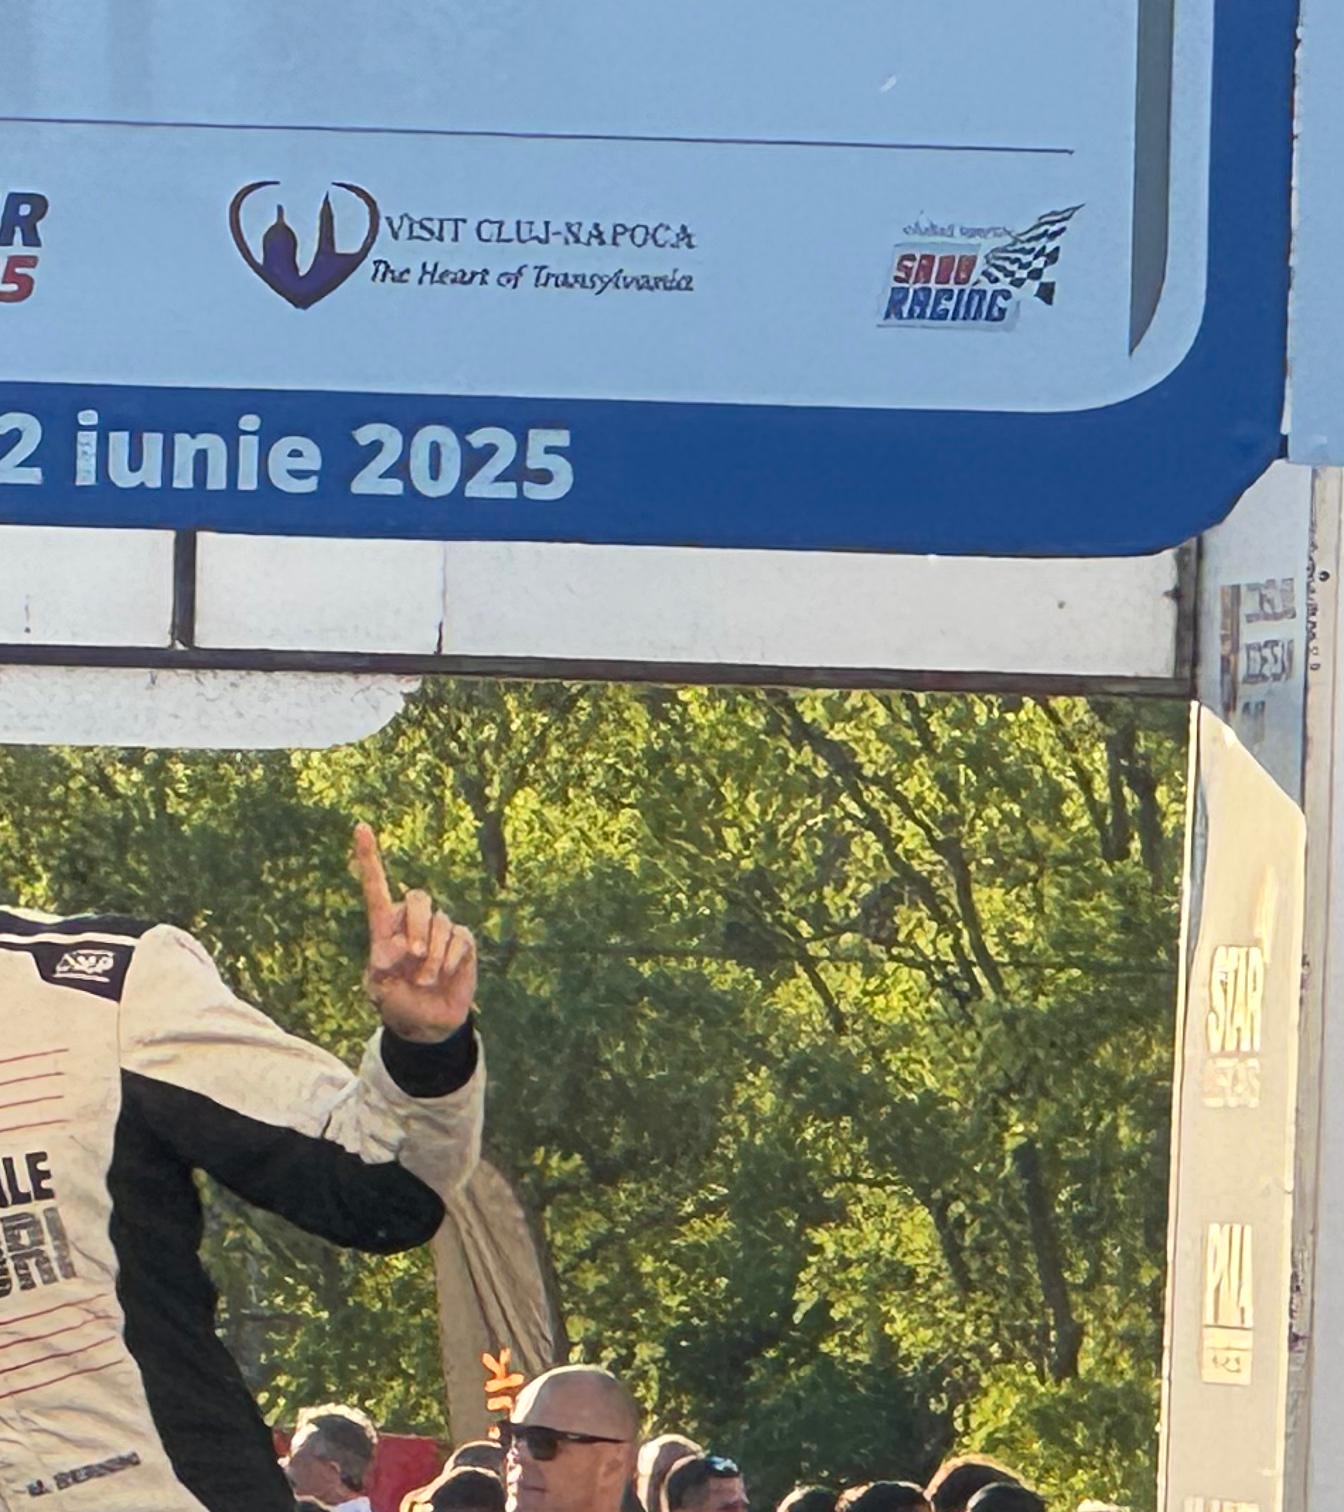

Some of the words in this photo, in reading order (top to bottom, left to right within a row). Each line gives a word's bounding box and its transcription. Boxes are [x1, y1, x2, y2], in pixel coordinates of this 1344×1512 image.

[384, 213, 468, 242] VISIT
[475, 217, 697, 250] CLUJ-NAPOCA
[417, 261, 491, 287] Heart
[497, 263, 529, 289] of
[533, 264, 695, 296] Transylvania
[883, 286, 1013, 323] RACING
[75, 408, 323, 495] iunie
[350, 421, 575, 502] 2025
